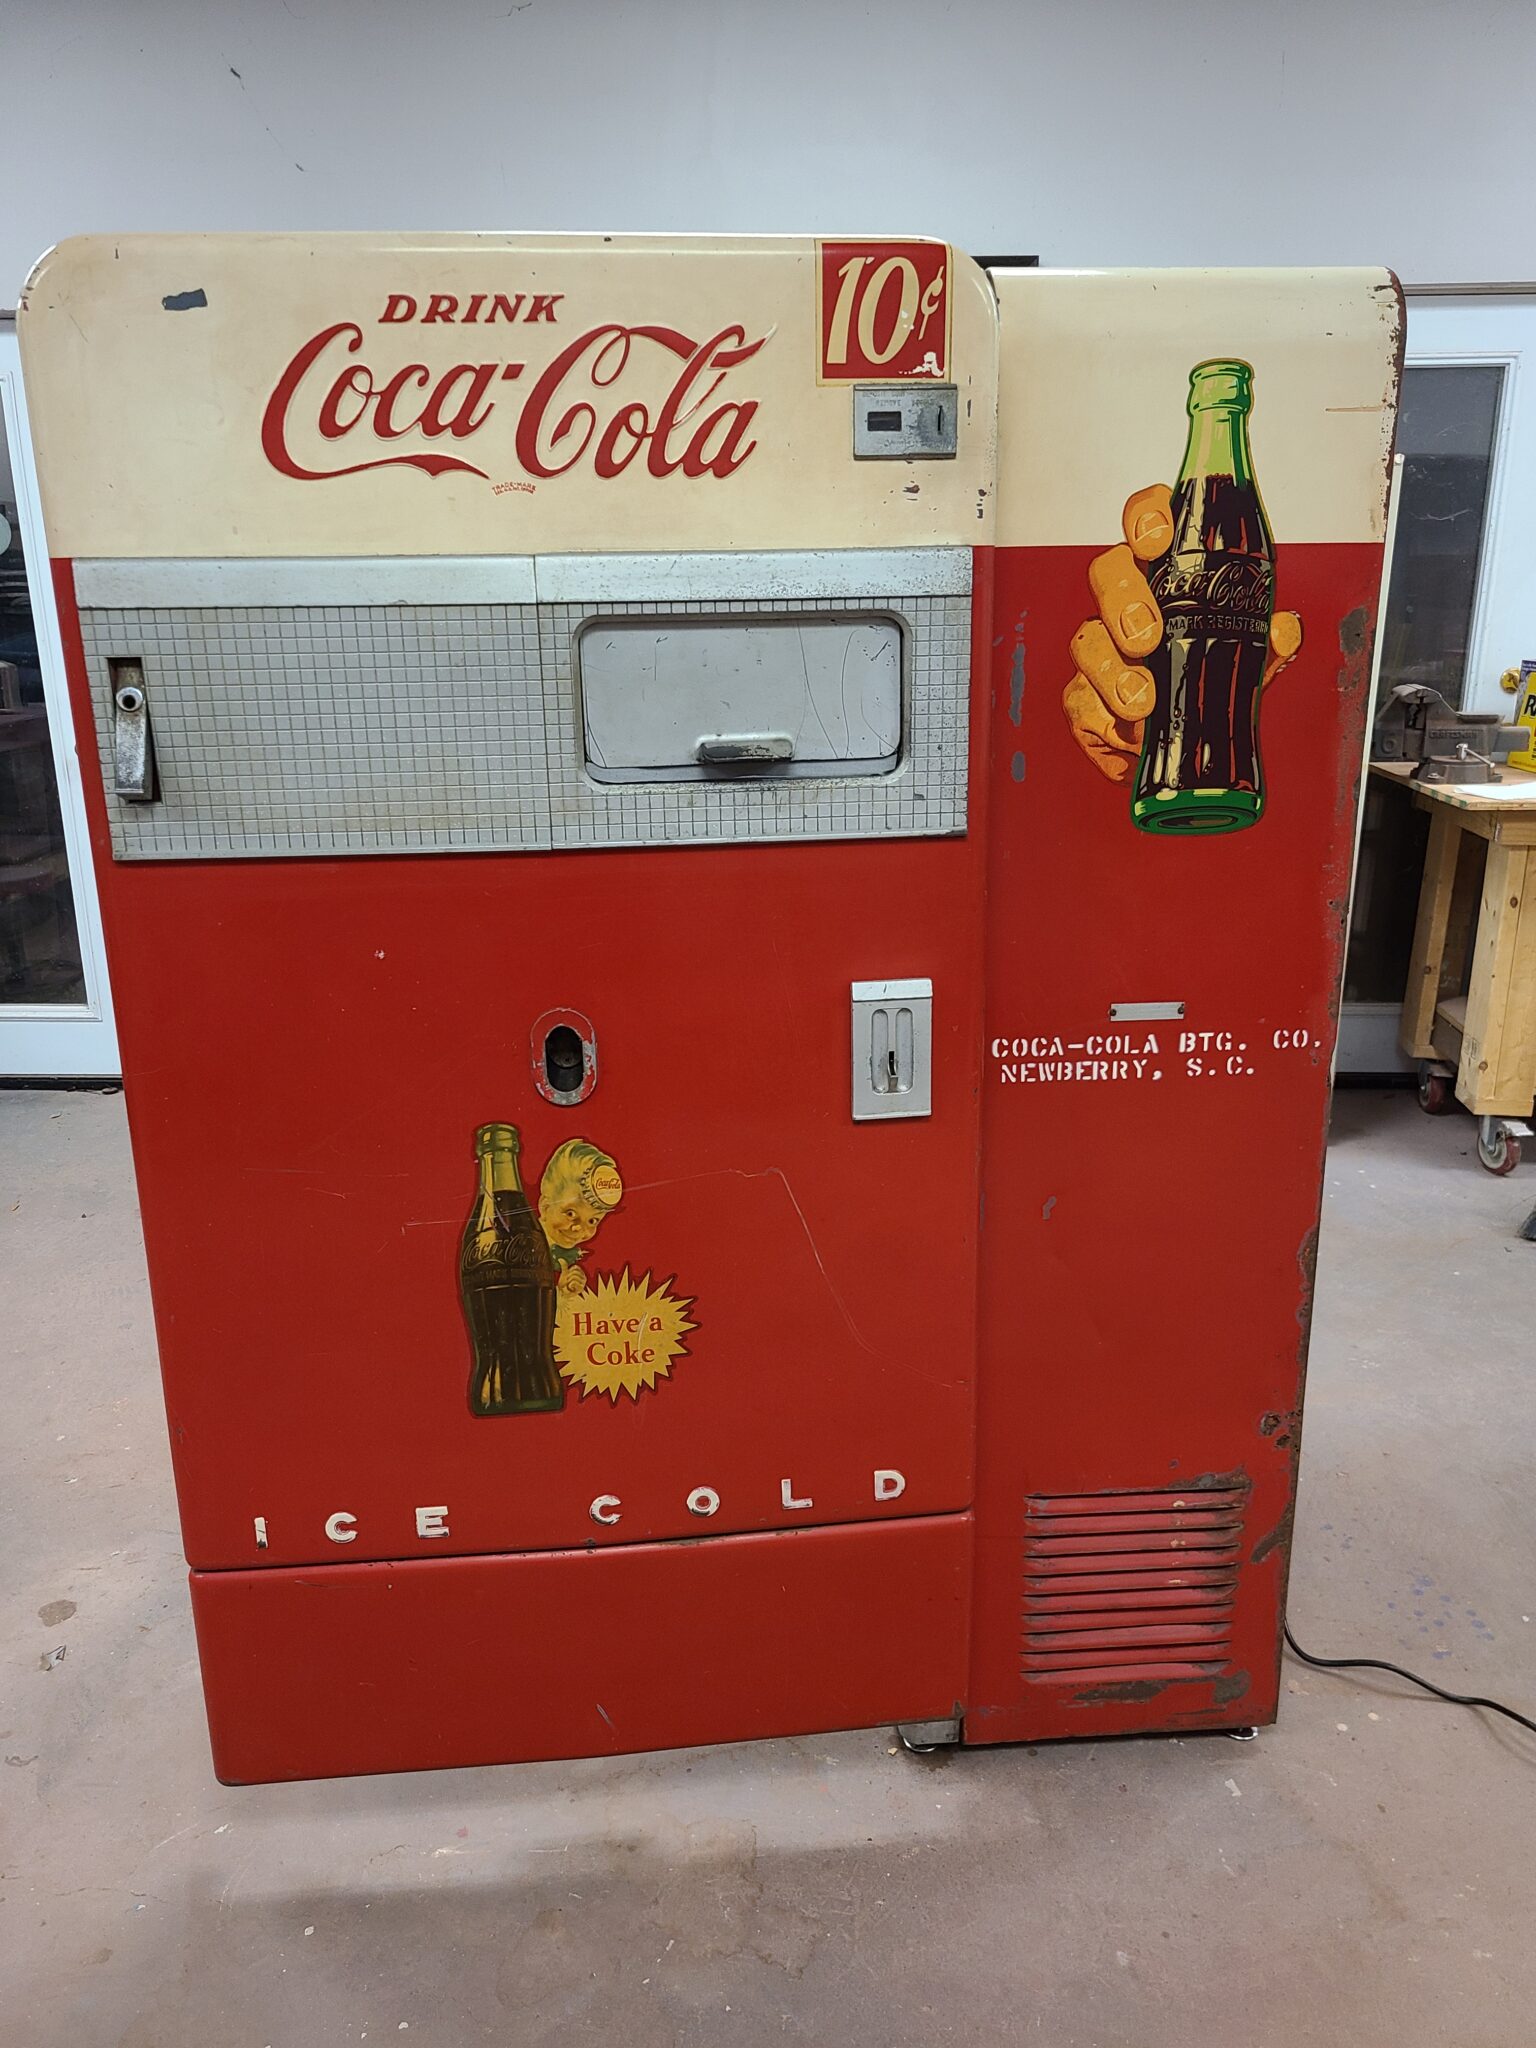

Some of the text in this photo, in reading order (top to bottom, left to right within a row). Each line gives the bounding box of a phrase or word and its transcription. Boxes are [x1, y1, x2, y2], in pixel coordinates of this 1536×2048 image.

[377, 294, 565, 323] DRINK
[826, 256, 944, 365] 10¢
[261, 322, 777, 481] Coca-Cola
[1168, 615, 1203, 632] MARK
[992, 1029, 1321, 1059] COCA-COLA BTG. CO.
[1001, 1059, 1162, 1084] NEWBERRY,
[572, 1312, 664, 1336] Have a
[586, 1342, 656, 1366] Coke
[254, 1469, 906, 1550] ICE COLD
